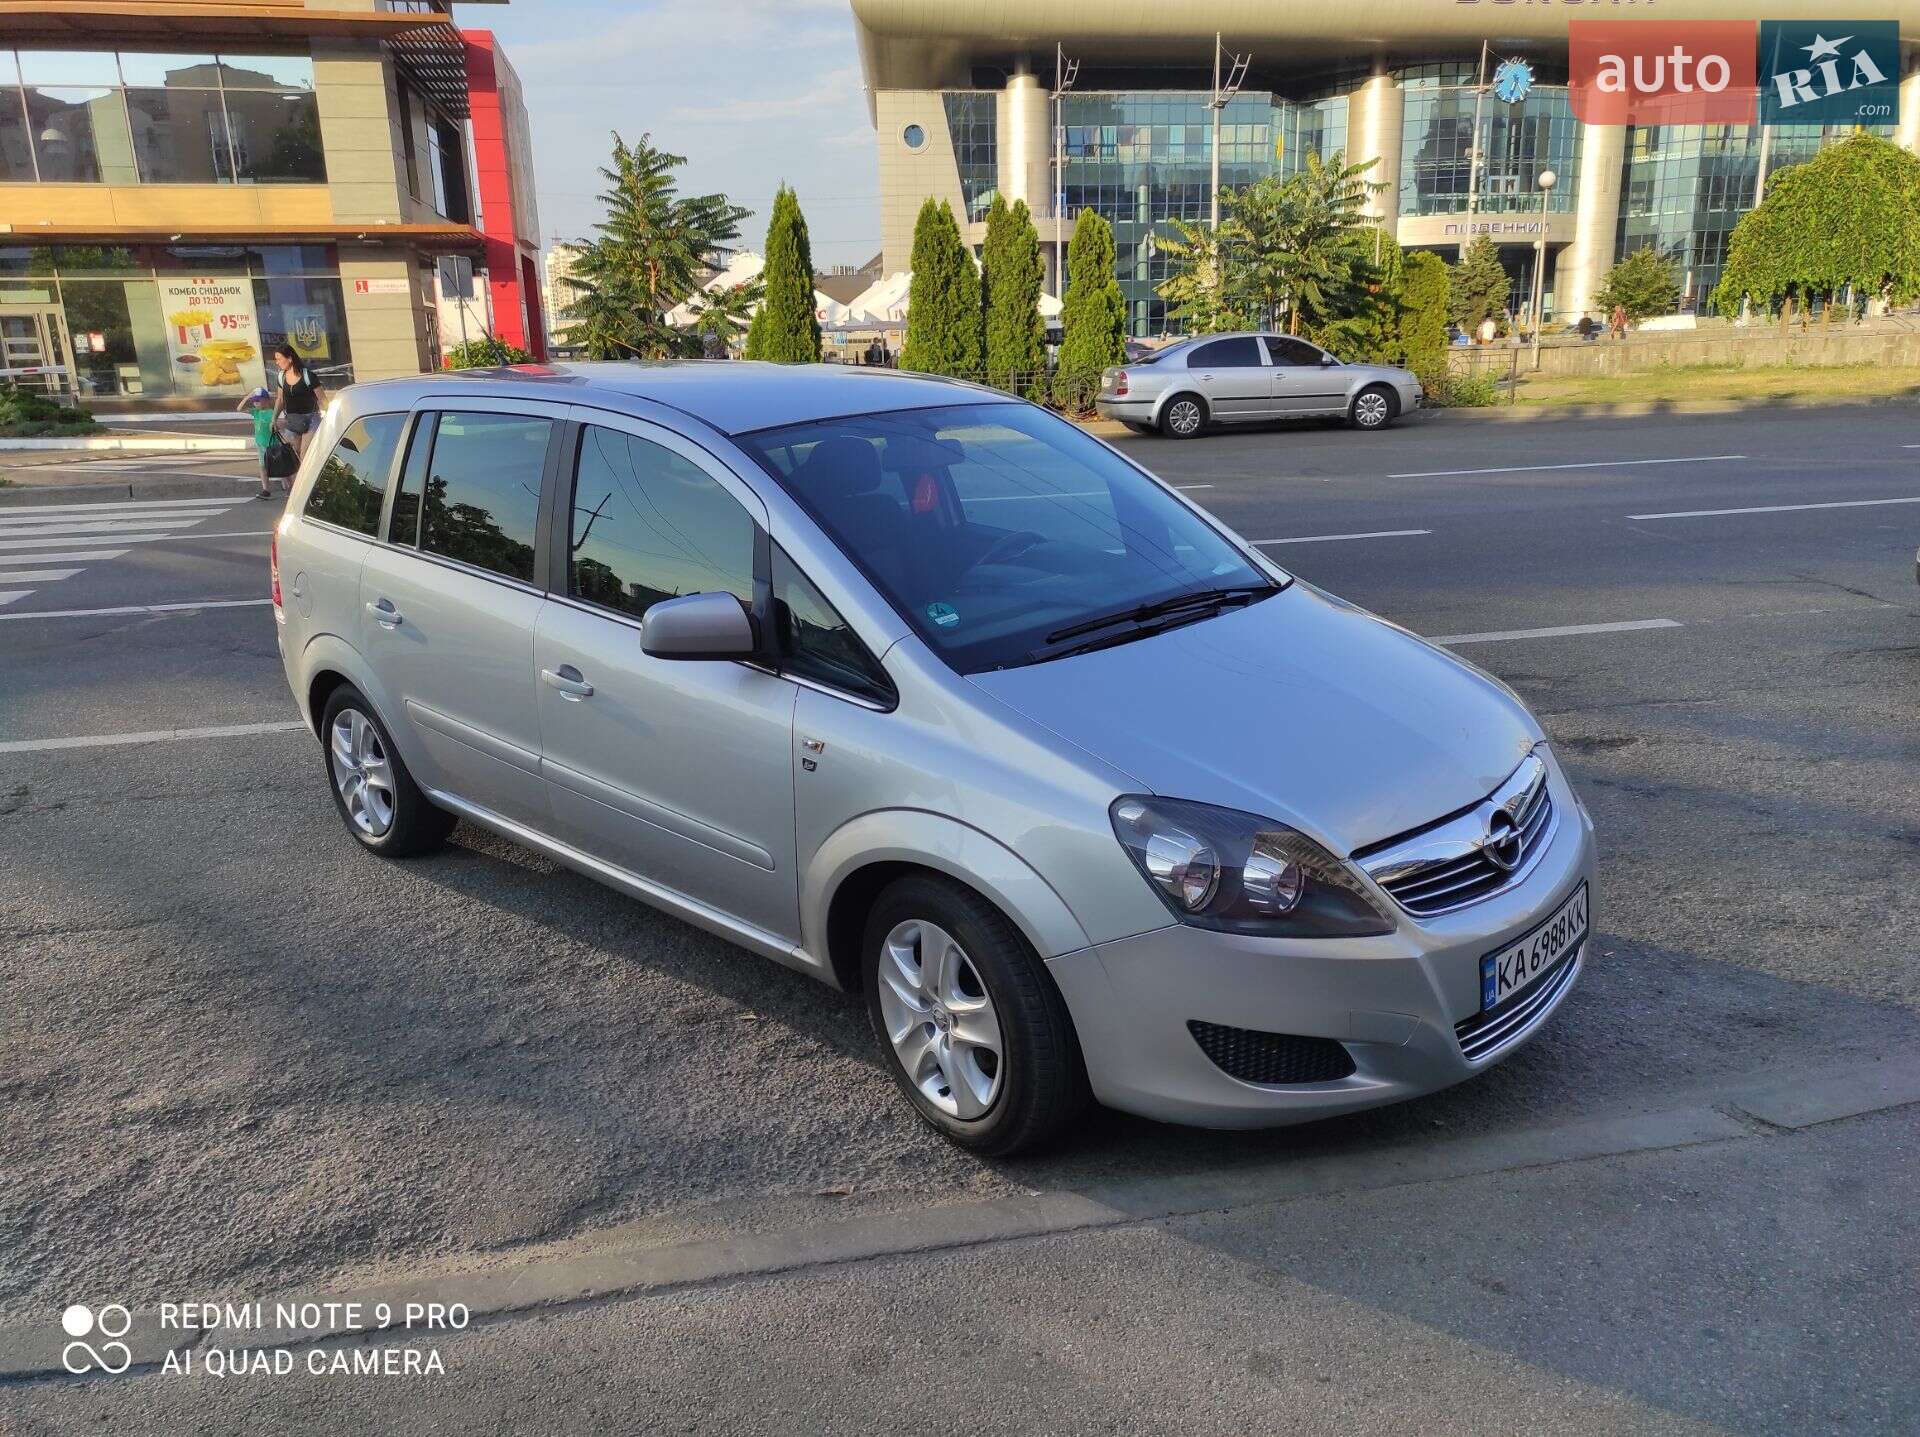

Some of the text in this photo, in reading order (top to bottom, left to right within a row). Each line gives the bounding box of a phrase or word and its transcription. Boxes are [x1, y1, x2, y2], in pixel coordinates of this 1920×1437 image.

[169, 287, 241, 295] КОМБО СНІДАНОК
[189, 296, 224, 305] ДО 12:00
[220, 315, 238, 329] 95
